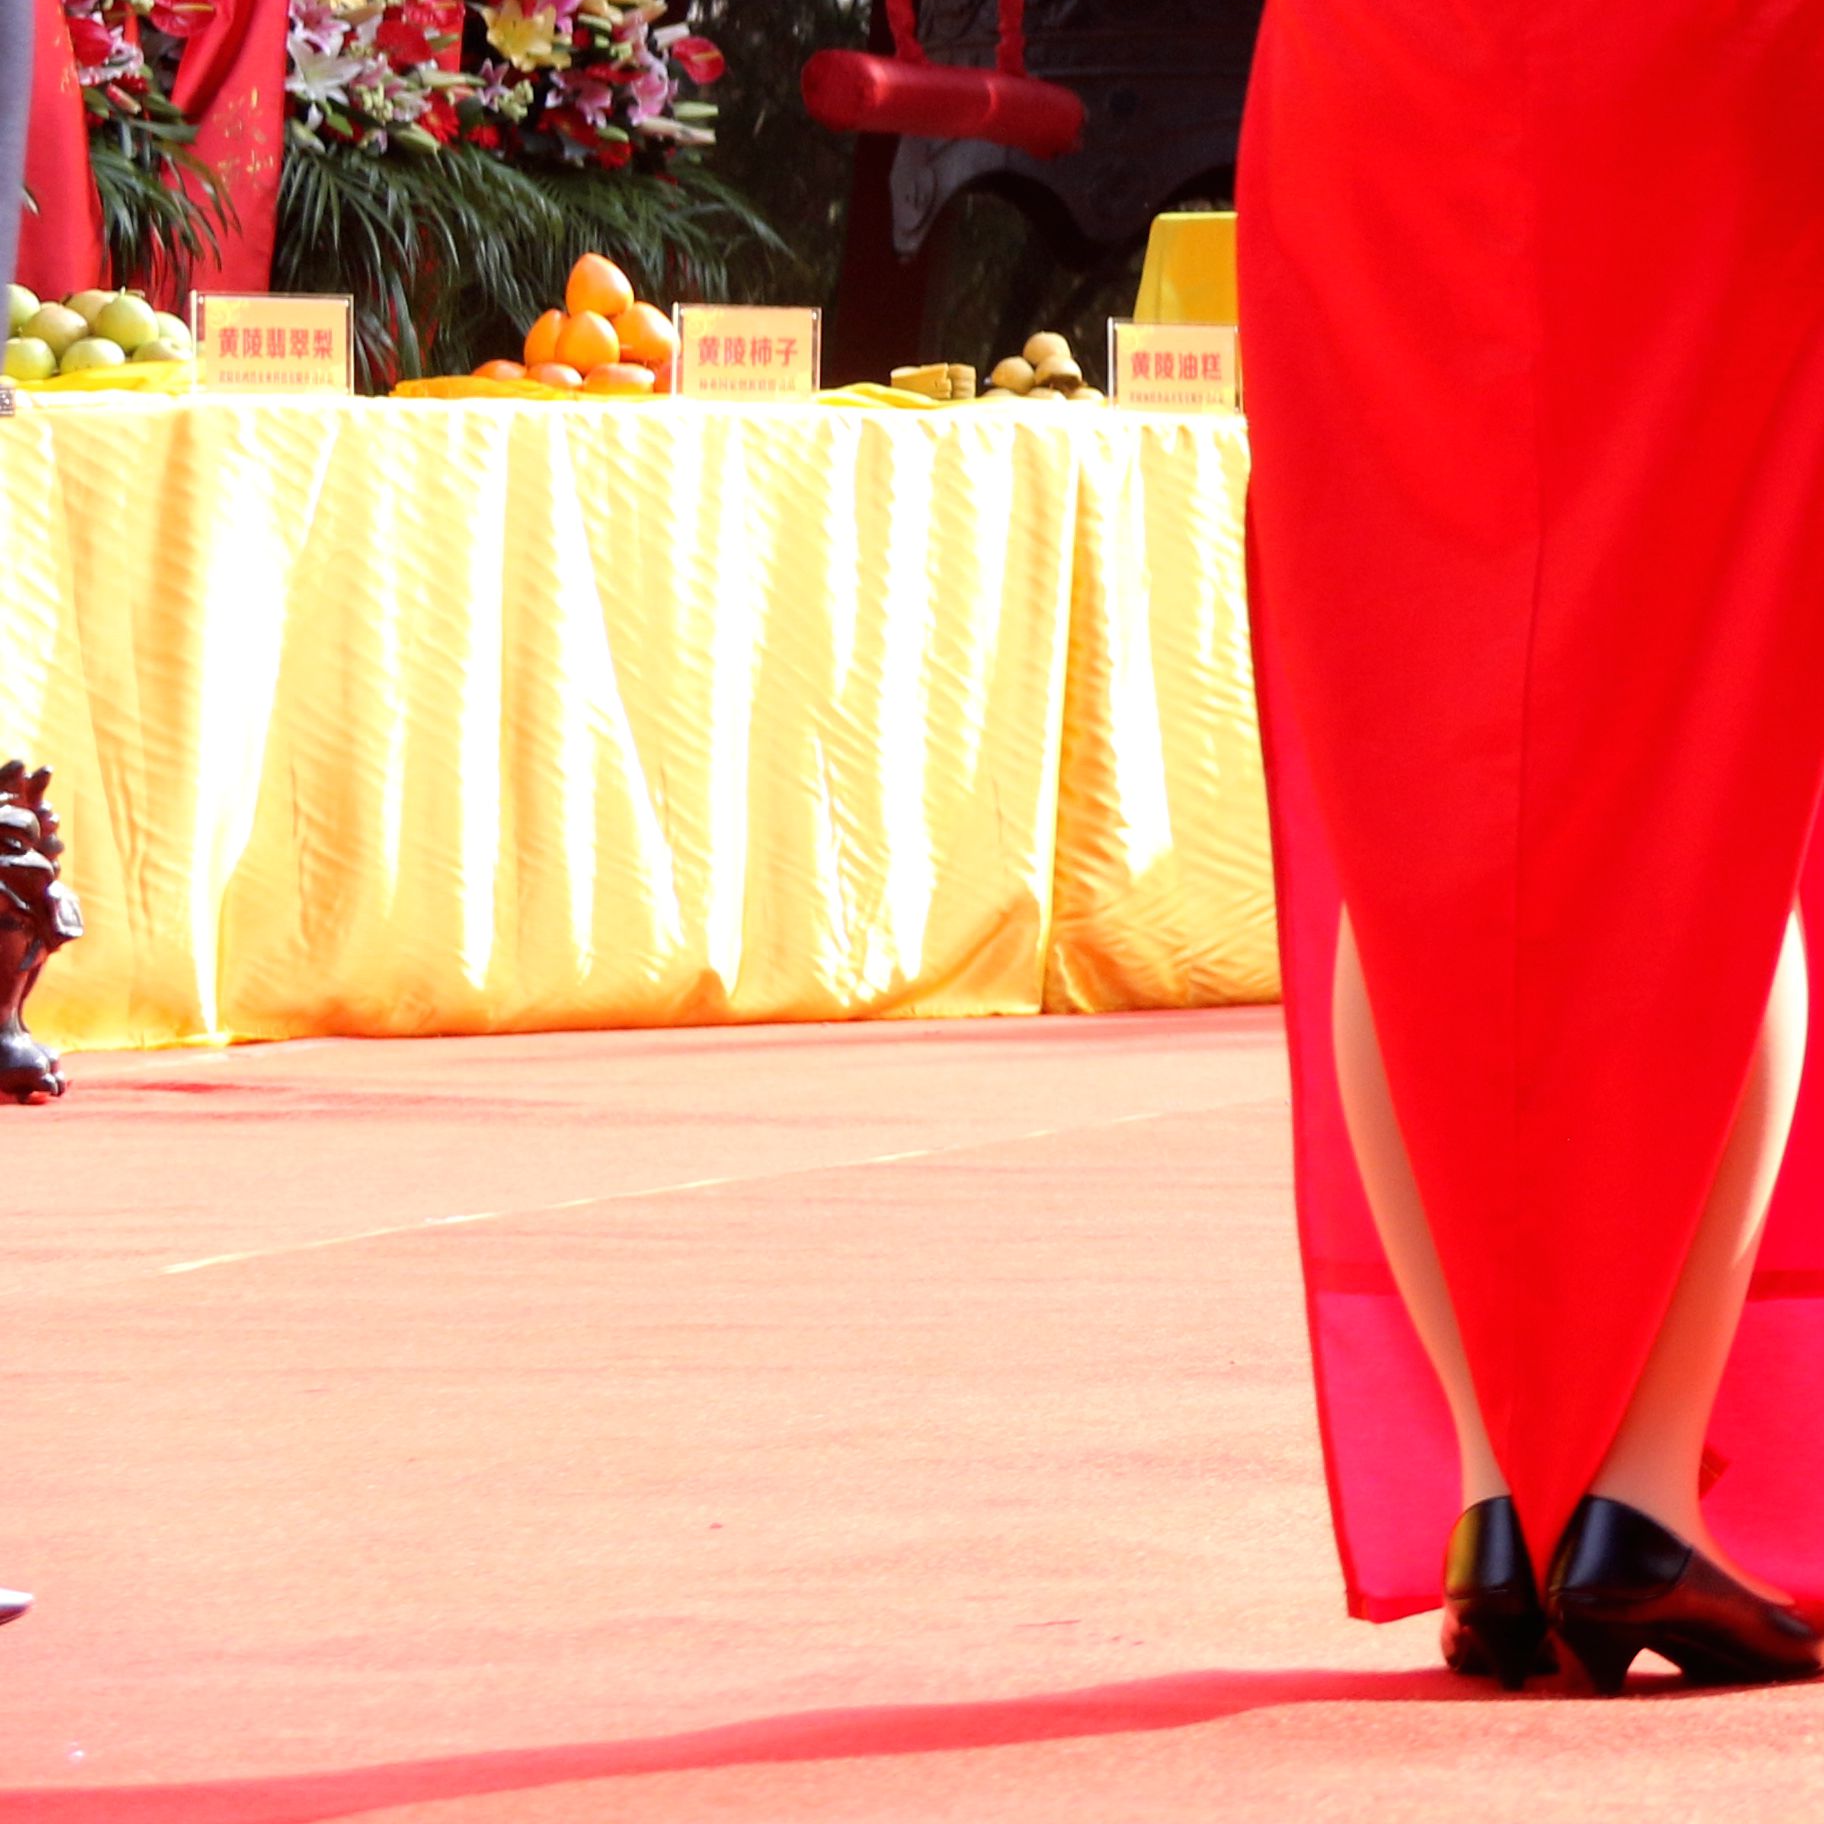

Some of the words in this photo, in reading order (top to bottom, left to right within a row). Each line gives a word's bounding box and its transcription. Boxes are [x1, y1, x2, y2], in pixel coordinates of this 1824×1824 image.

[219, 327, 333, 360] 黄陵翡翠梨
[698, 335, 797, 368] 黄陵柿子
[1131, 351, 1222, 381] 黄陵油糕
